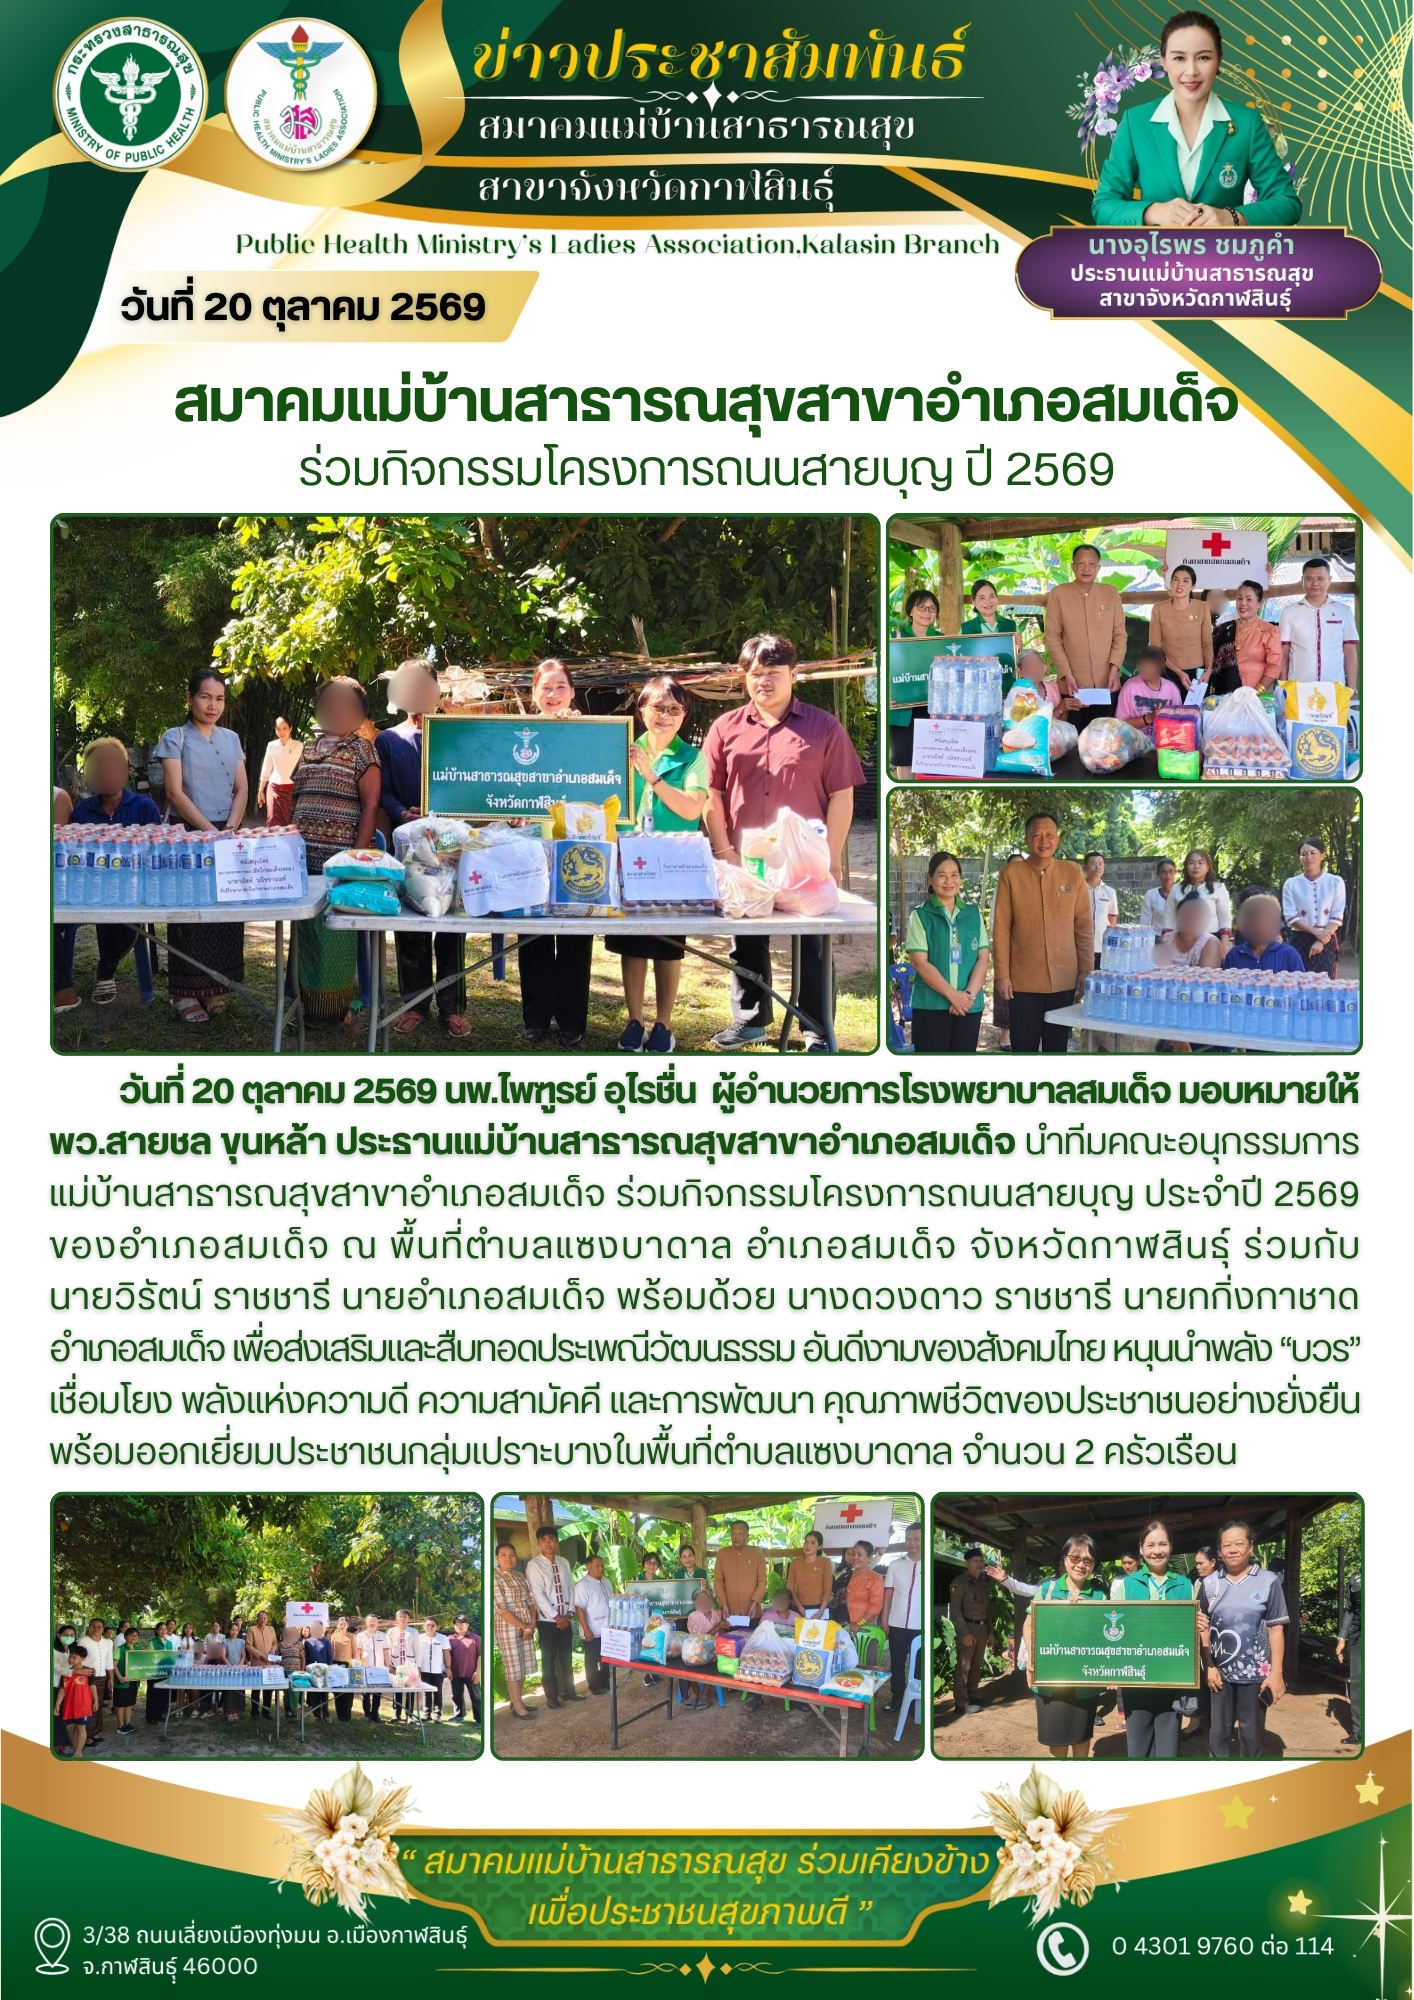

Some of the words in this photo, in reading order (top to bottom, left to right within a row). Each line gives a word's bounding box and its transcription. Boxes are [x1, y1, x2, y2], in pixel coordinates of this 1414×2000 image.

[67, 24, 194, 75] กระทรวงสาธารณสุข
[474, 22, 972, 81] ข่าวประชาสัมพันธ์
[252, 89, 268, 118] PUBLIC
[332, 88, 348, 141] ASSOCIATION
[66, 107, 104, 153] MINISTRY
[105, 148, 121, 161] OF
[125, 144, 165, 163] PUBLIC
[165, 107, 196, 148] HEALTH
[253, 120, 270, 150] HEALTH
[479, 106, 915, 151] สมาคมแม่บ้านสาธารณสุข
[314, 141, 339, 162] LADIES
[479, 166, 835, 213] สาขาจังหวัดกาฬสินธุ์
[237, 233, 315, 254] Public
[324, 233, 408, 254] Health
[551, 233, 636, 254] Ladies
[904, 233, 1000, 254] Branch
[1089, 231, 1207, 261] นางอุไรพร
[1215, 232, 1295, 262] ชมภูคำ
[1071, 261, 1314, 288] ประธานแม่บ้านสาธารณสุข
[121, 277, 194, 321] วันที่
[204, 292, 252, 321] 20
[262, 296, 380, 332] ตุลาคม
[390, 292, 486, 321] 2569
[1099, 287, 1292, 312] สาขาจังหวัดกาฬสินธุ์
[175, 370, 1239, 438] สมาคมแม่บ้านสาธารณสุขสาขาอำเภอสมเด็จ
[300, 443, 952, 500] ร่วมกิจกรรมโครงการถนนสายบุญ
[965, 443, 992, 487] ปี
[1007, 452, 1114, 487] 2569
[432, 767, 622, 787] แม่บ้านสาธารณสุขสาขาอำเภอสมเด็จ
[119, 1063, 184, 1104] วันที่
[192, 1077, 235, 1104] 20
[242, 1081, 345, 1114] ตุลาคม
[353, 1077, 437, 1104] 2569
[445, 1071, 598, 1114] นพ.ไพฑูรย์
[604, 1063, 696, 1114] อุไรชื่น
[712, 1071, 1172, 1114] ผู้อำนวยการโรงพยาบาลสมเด็จ
[1179, 1071, 1360, 1104] มอบหมายให้
[49, 1130, 211, 1155] พว.สายชล
[220, 1122, 326, 1165] ขุนหล้า
[336, 1122, 1016, 1165] ประธานแม่บ้านสาธารณสุขสาขาอำเภอสมเด็จ
[1026, 1122, 1359, 1165] นำทีมคณะอนุกรรมการ
[50, 1174, 605, 1217] แม่บ้านสาธารณสุขสาขาอำเภอสมเด็จ
[617, 1174, 1133, 1217] ร่วมกิจกรรมโครงการถนนสายบุญ
[1146, 1174, 1262, 1207] ประจำปี
[1274, 1180, 1359, 1207] 2569
[49, 1226, 328, 1259] ของอำเภอสมเด็จ
[343, 1236, 375, 1259] ณ
[390, 1218, 731, 1259] พื้นที่ตำบลแซงบาดาล
[747, 1226, 955, 1259] อำเภอสมเด็จ
[970, 1227, 1231, 1269] จังหวัดกาฬสินธุ์
[1244, 1226, 1359, 1259] ร่วมกับ
[50, 1278, 203, 1310] นายวิรัตน์
[214, 1277, 330, 1310] ราชชารี
[343, 1277, 605, 1310] นายอำเภอสมเด็จ
[617, 1277, 775, 1310] พร้อมด้วย
[788, 1287, 982, 1310] นางดวงดาว
[995, 1277, 1111, 1310] ราชชารี
[1124, 1274, 1358, 1310] นายกกิ่งกาชาด
[50, 1329, 225, 1362] อำเภอสมเด็จ
[233, 1321, 795, 1362] เพื่อส่งเสริมและสืบทอดประเพณีวัฒนธรรม
[803, 1329, 1106, 1362] อันดีงามของสังคมไทย
[1114, 1329, 1273, 1372] หนุนนำพลัง
[1280, 1336, 1361, 1362] “บวร”
[50, 1373, 172, 1414] เชื่อมโยง
[181, 1381, 408, 1414] พลังแห่งความดี
[418, 1381, 600, 1414] ความสามัคคี
[611, 1382, 814, 1414] และการพัฒนา
[824, 1374, 1360, 1424] คุณภาพชีวิตของประชาชนอย่างยั่งยืน
[49, 1424, 952, 1475] พร้อมออกเยี่ยมประชาชนกลุ่มเปราะบางในพื้นที่ตำบลแซงบาดาล
[962, 1432, 1065, 1465] จำนวน
[1075, 1438, 1094, 1465] 2
[1105, 1432, 1236, 1465] ครัวเรือน
[1039, 1643, 1190, 1659] แม่บ้านสาธารณสุขสาขาอำเภอสมเด็จ
[1081, 1665, 1147, 1681] จังหวัดกาฬสินธุ์
[423, 1842, 787, 1885] สมาคมแม่บ้านสาธารณสุข
[796, 1842, 990, 1875] ร่วมเคียงข้าง
[527, 1886, 849, 1935] เพื่อประชาชนสุขภาพดี
[83, 1926, 130, 1945] 3/38
[136, 1919, 320, 1949] ถนนเลี่ยงเมืองทุ่งมน
[327, 1924, 469, 1949] อ.เมืองกาฬสินธุ์
[1112, 1937, 1127, 1955] 0
[1134, 1937, 1190, 1955] 4301
[1197, 1937, 1254, 1955] 9760
[1261, 1934, 1288, 1955] ต่อ
[1296, 1937, 1334, 1955] 114
[83, 1956, 178, 1984] จ.กาฬสินธุ์
[183, 1957, 257, 1975] 46000
